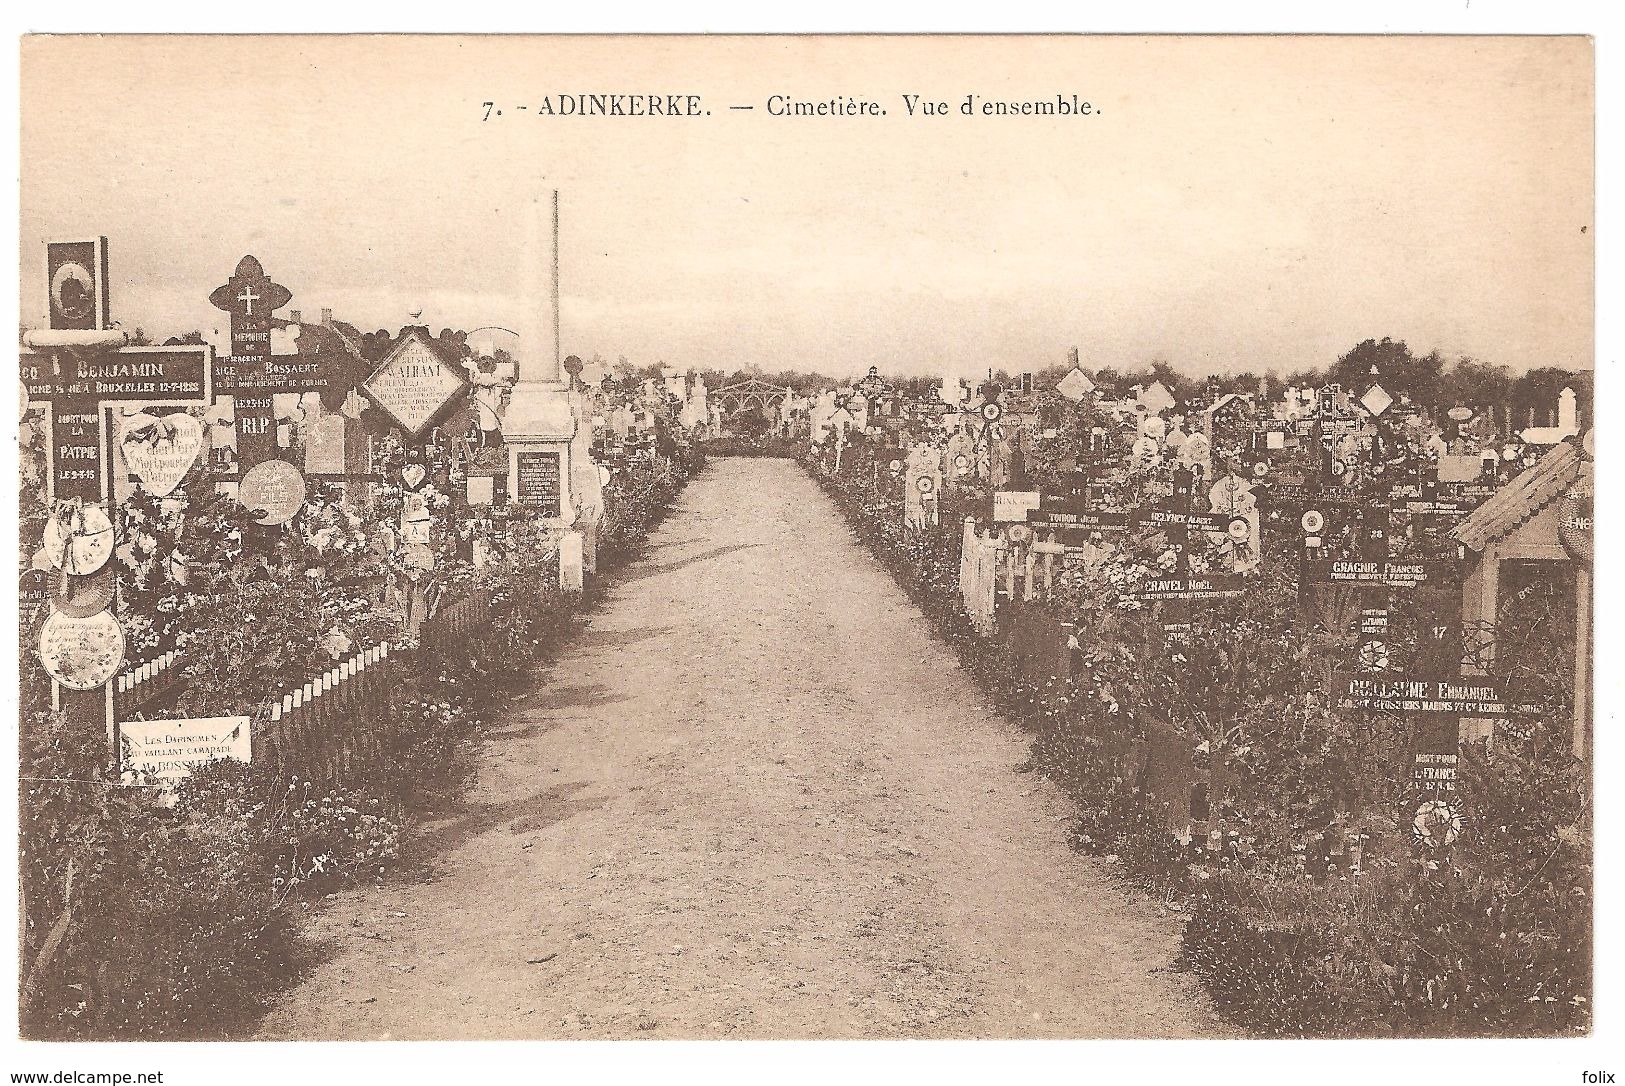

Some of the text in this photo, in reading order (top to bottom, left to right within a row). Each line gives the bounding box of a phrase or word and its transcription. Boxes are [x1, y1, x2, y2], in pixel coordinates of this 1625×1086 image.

[78, 360, 165, 379] BENJAMIN
[95, 380, 156, 393] BRUXELLES
[71, 426, 84, 436] LA
[1433, 626, 1448, 639] 17
[144, 748, 184, 758] VAILLANT
[1435, 753, 1458, 765] POUR
[1424, 767, 1458, 781] FRANCE
